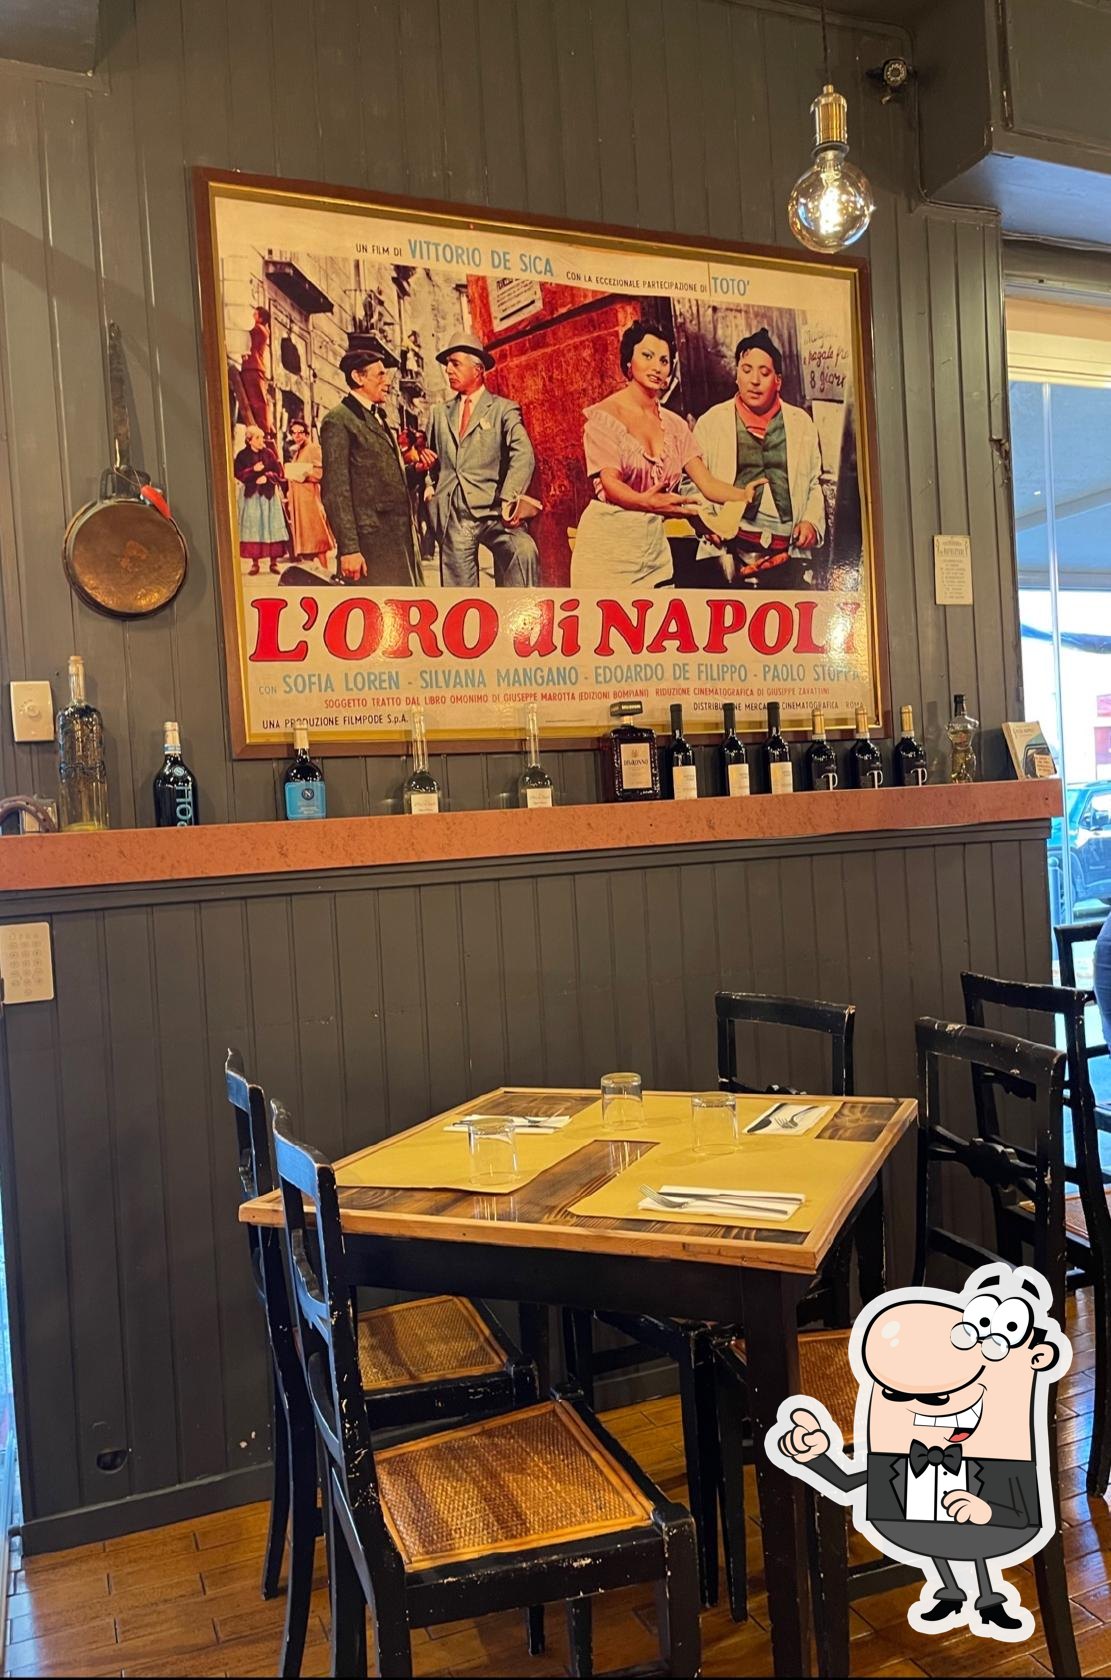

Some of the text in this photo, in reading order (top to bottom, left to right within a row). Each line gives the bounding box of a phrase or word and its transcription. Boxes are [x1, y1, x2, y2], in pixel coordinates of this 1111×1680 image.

[356, 239, 554, 276] UN FILM DI VITTORIO DE SICA
[566, 271, 750, 296] CON LA ECCEZIONALE PARTECIPAZIONE DI TOTO'
[248, 596, 860, 662] L'ORO di NAPOLI
[258, 685, 277, 696] CON
[282, 672, 335, 694] SOFIA
[344, 671, 400, 692] LOREN
[420, 669, 487, 689] SILVANA
[496, 666, 579, 687] MANGANO
[594, 663, 665, 684] EDOARDO
[672, 663, 690, 681] DE
[698, 663, 748, 682] FILIPPO
[762, 663, 806, 682] PAOLO
[324, 698, 367, 709] SOGGETTO
[372, 696, 400, 707] TRATTO
[405, 696, 420, 706] DAL
[424, 695, 446, 705] LIBRO
[450, 694, 488, 704] OMONIMO
[492, 694, 500, 703] DI
[503, 692, 538, 703] GIUSEPPE
[540, 690, 576, 701] MAROTTA
[655, 687, 830, 697] RIDUZIONE CINEMATOGRAFICA DI GIUSEPPE ZAVATTINI
[782, 702, 838, 710] CINEMATOGRAFICA
[262, 720, 280, 729] UNA
